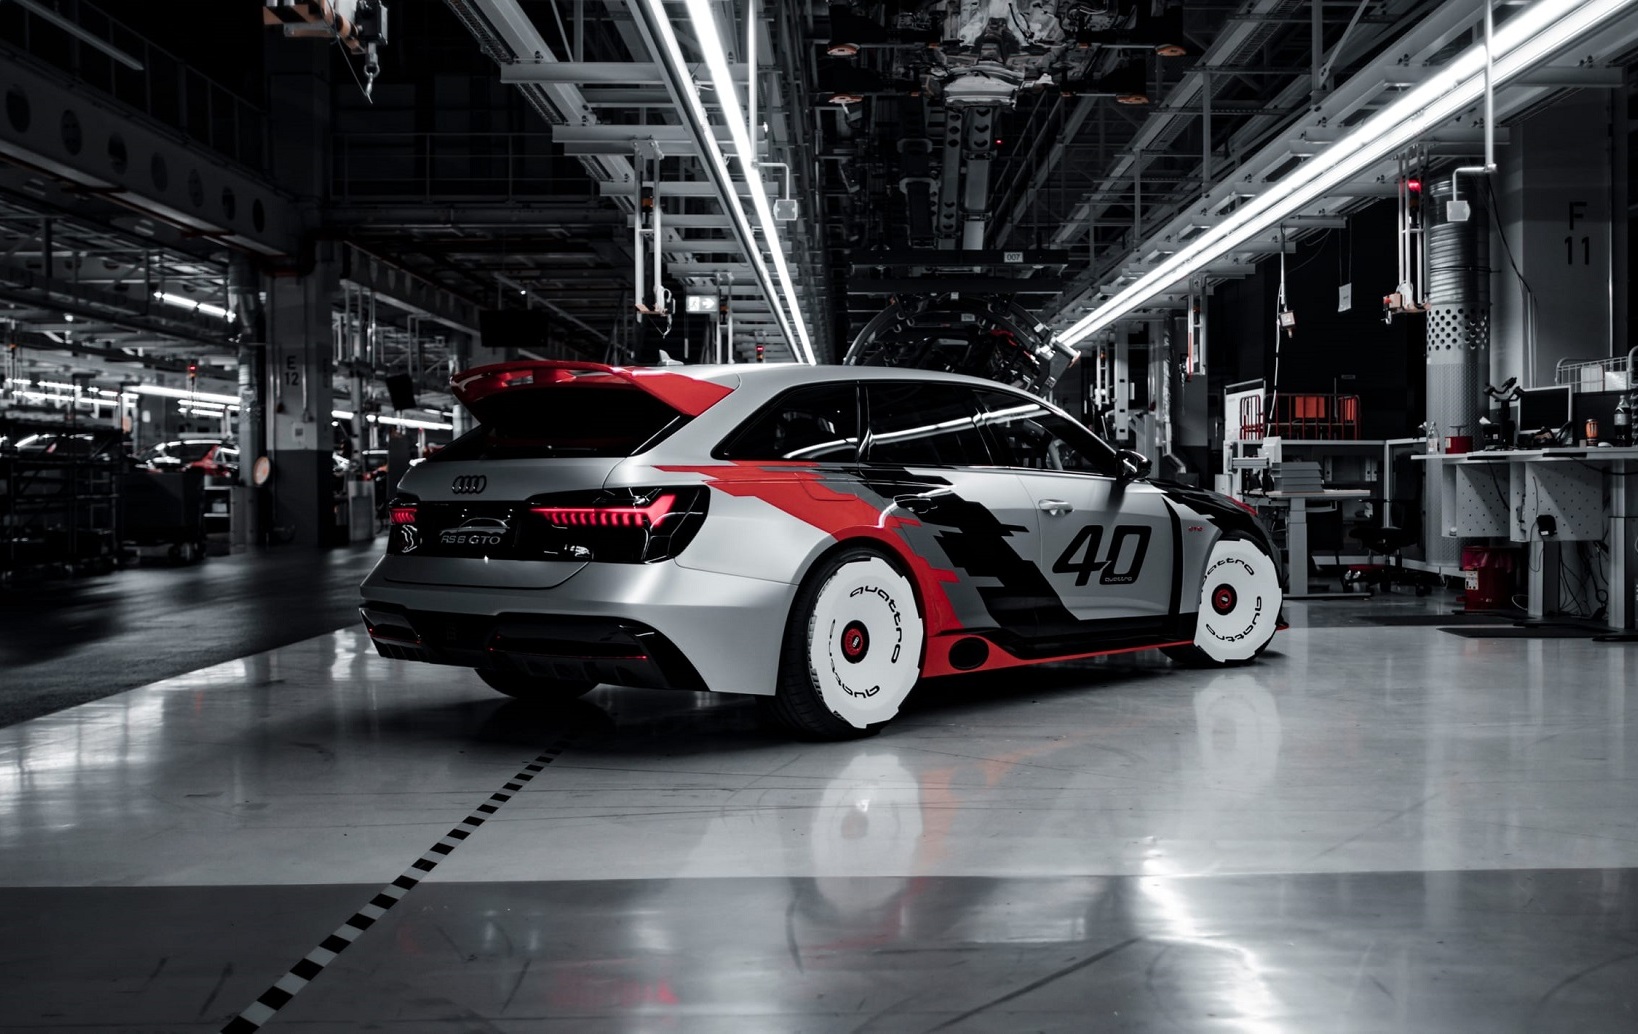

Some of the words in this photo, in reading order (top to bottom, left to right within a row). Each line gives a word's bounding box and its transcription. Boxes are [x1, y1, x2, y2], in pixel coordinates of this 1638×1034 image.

[1569, 201, 1587, 230] F
[1006, 253, 1021, 261] 007
[1564, 236, 1589, 265] 11
[287, 355, 297, 370] E
[284, 371, 299, 386] 12
[468, 535, 501, 545] GTO
[1052, 525, 1152, 586] 40
[850, 585, 902, 663] quattro
[1206, 596, 1262, 642] quattro
